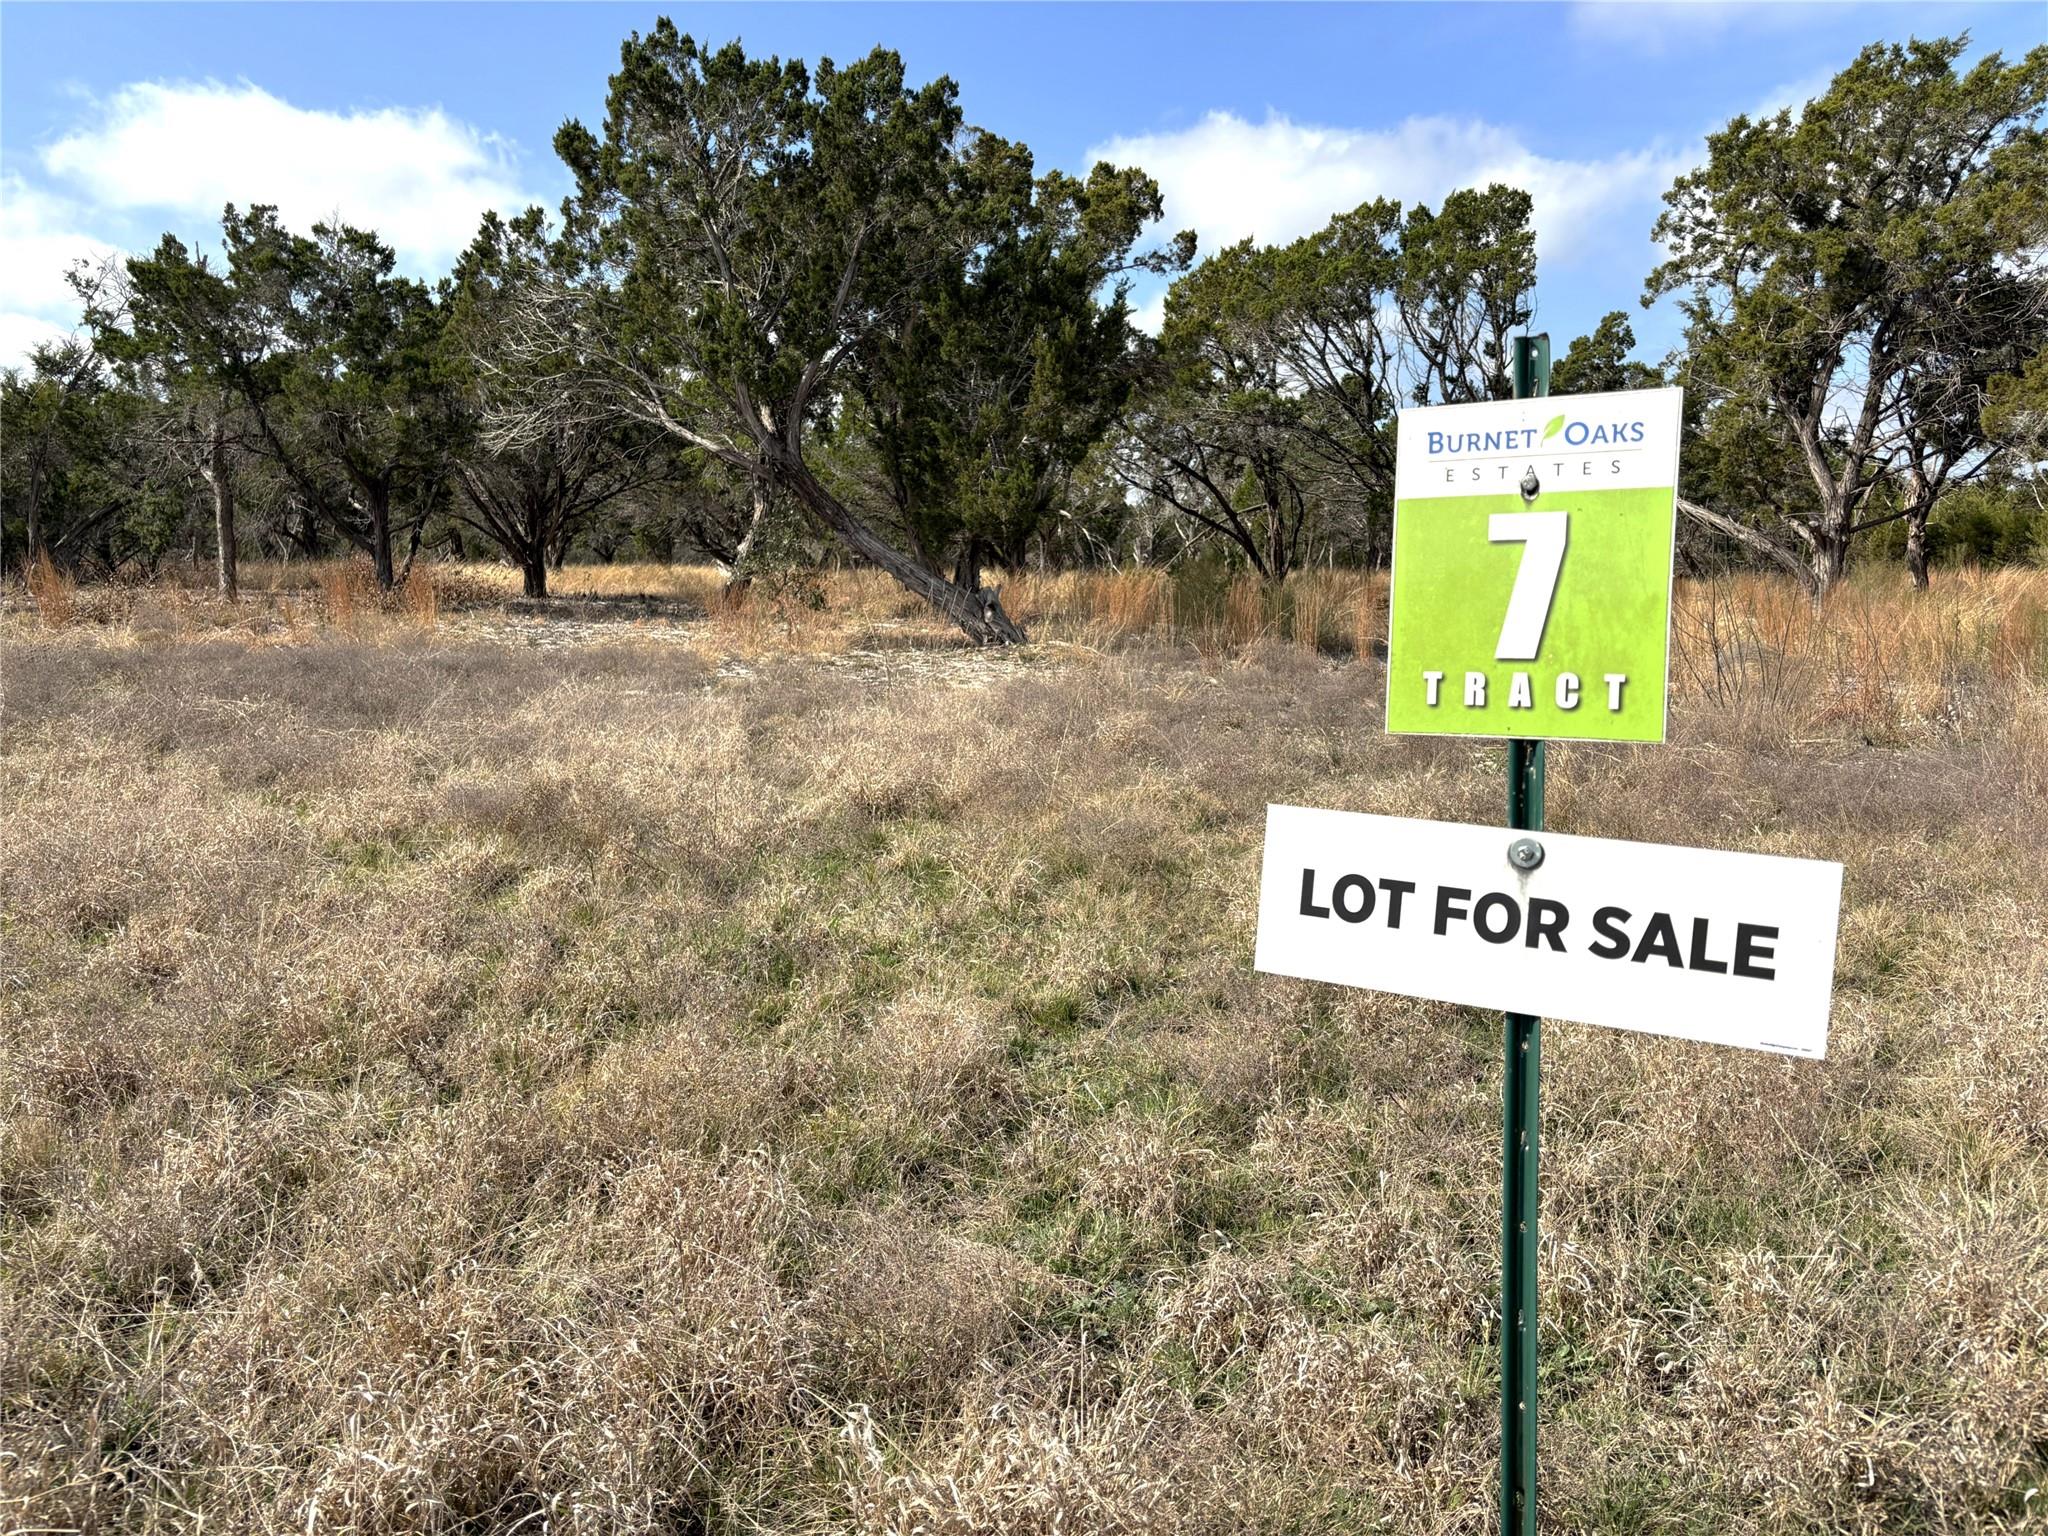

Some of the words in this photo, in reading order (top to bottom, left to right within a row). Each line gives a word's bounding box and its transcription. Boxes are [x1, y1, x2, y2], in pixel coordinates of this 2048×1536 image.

[1427, 429, 1538, 455] BURNET
[1564, 421, 1644, 446] OAKS
[1445, 458, 1621, 483] ESTATES
[1487, 511, 1571, 661] 7
[1423, 671, 1628, 711] TRACT
[1299, 868, 1416, 930] LOT
[1433, 885, 1570, 954] FOR
[1588, 906, 1780, 981] SALE
